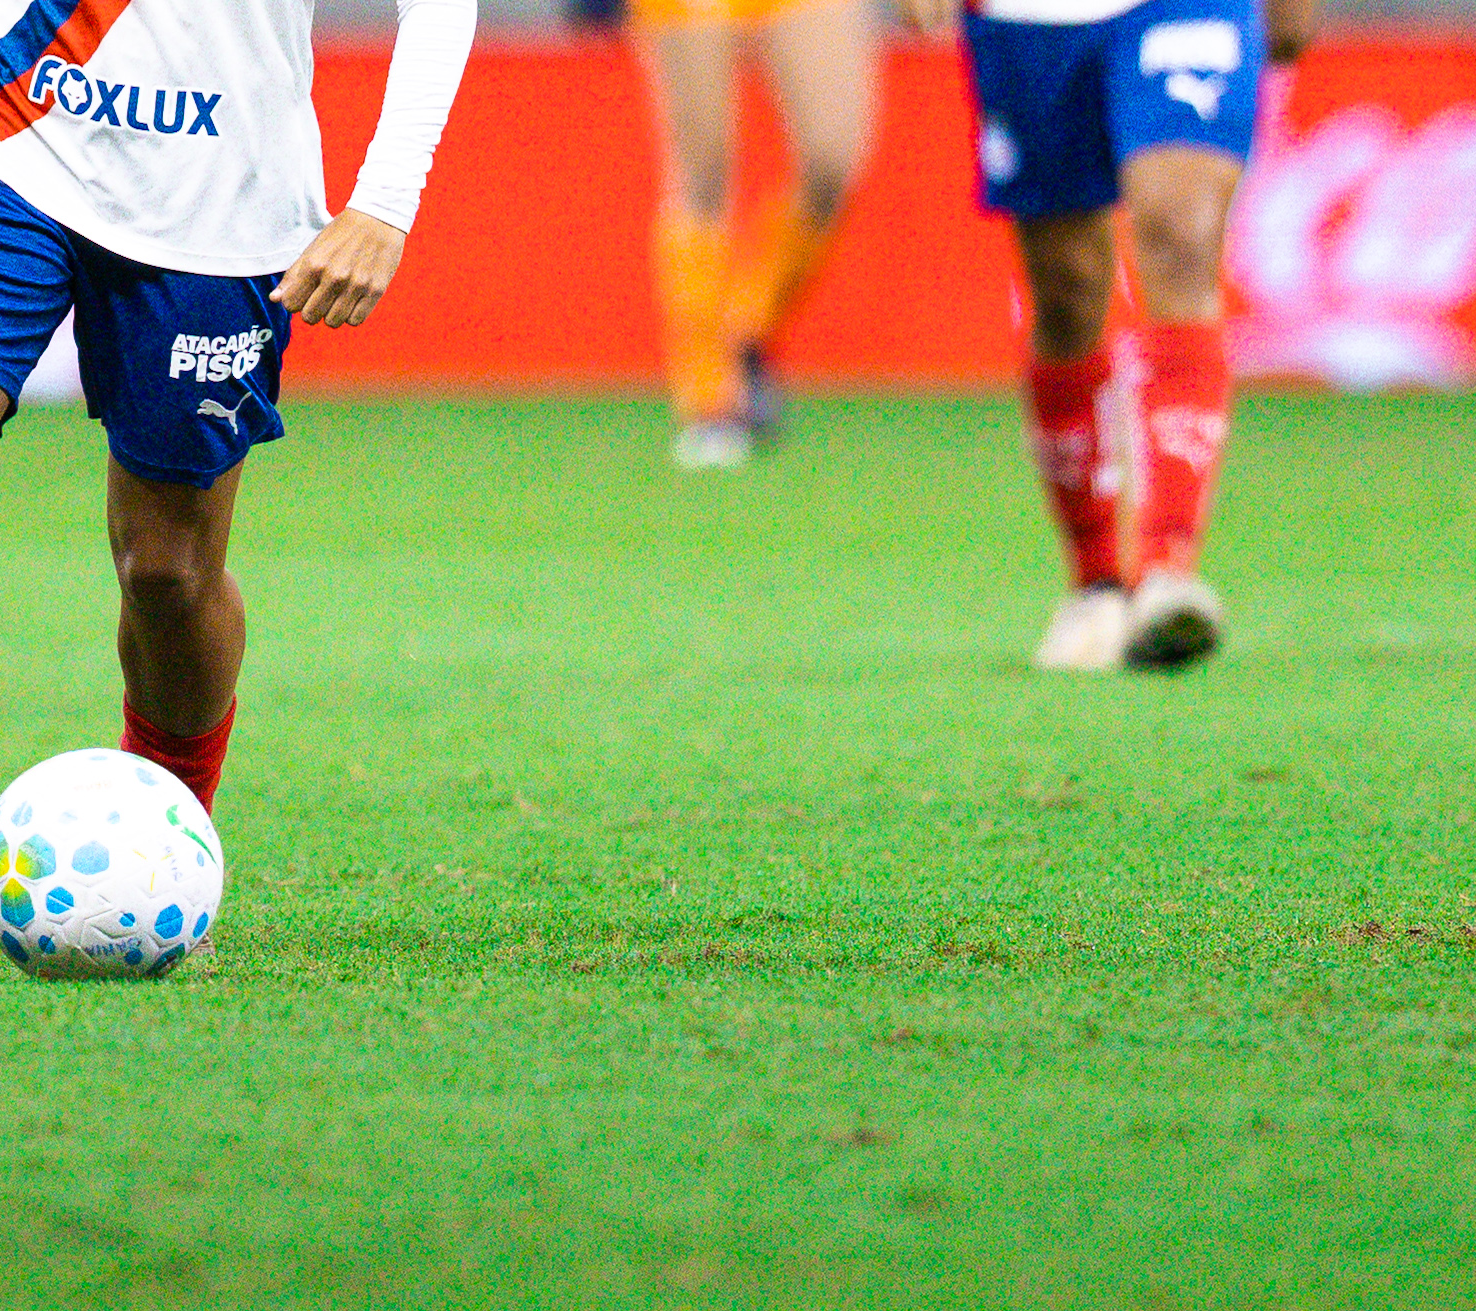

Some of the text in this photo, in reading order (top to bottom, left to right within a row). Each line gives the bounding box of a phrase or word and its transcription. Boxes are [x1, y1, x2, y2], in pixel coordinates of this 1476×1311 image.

[31, 59, 223, 137] FOXLUX
[170, 324, 273, 355] ATACADÃO
[169, 342, 265, 383] PISOS
